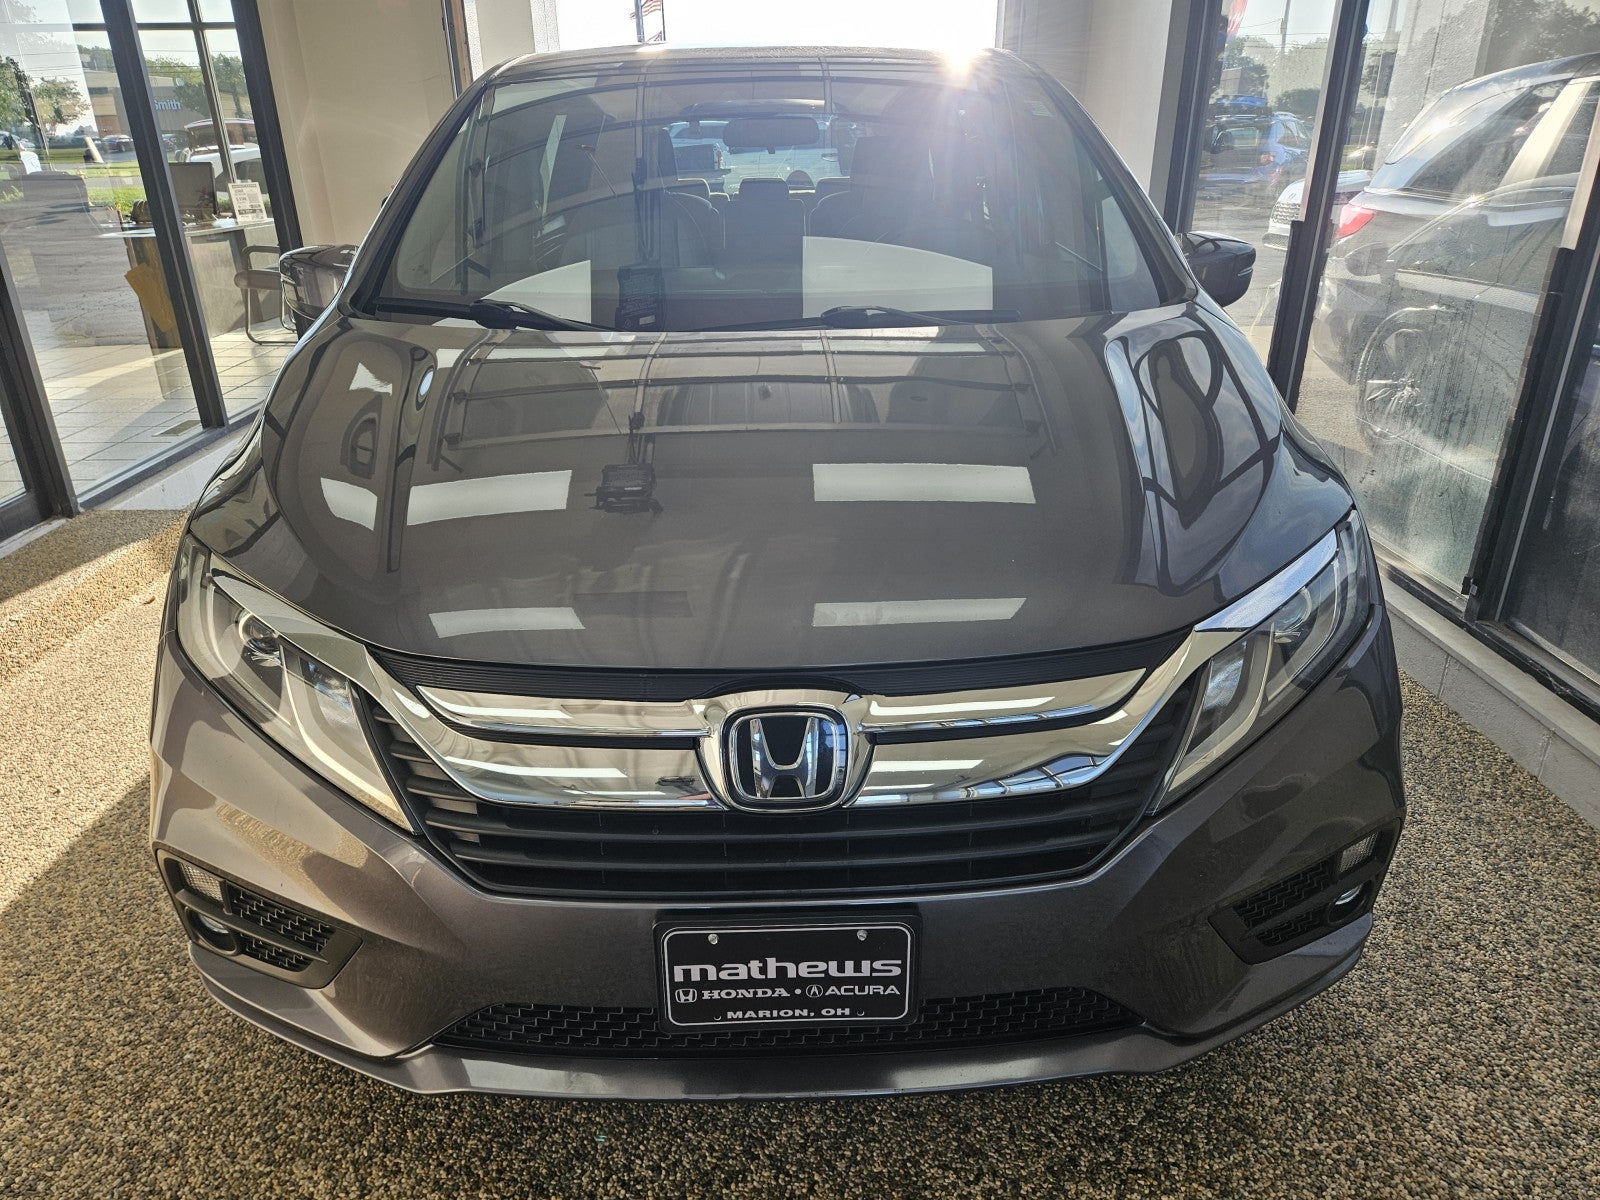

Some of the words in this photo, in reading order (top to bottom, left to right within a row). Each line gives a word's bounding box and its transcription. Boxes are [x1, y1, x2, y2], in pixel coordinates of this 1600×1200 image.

[674, 957, 902, 982] mathews
[702, 987, 790, 1000] HONDA
[825, 985, 900, 996] ACURA
[727, 1008, 815, 1018] MARION,
[821, 1007, 850, 1016] OH
